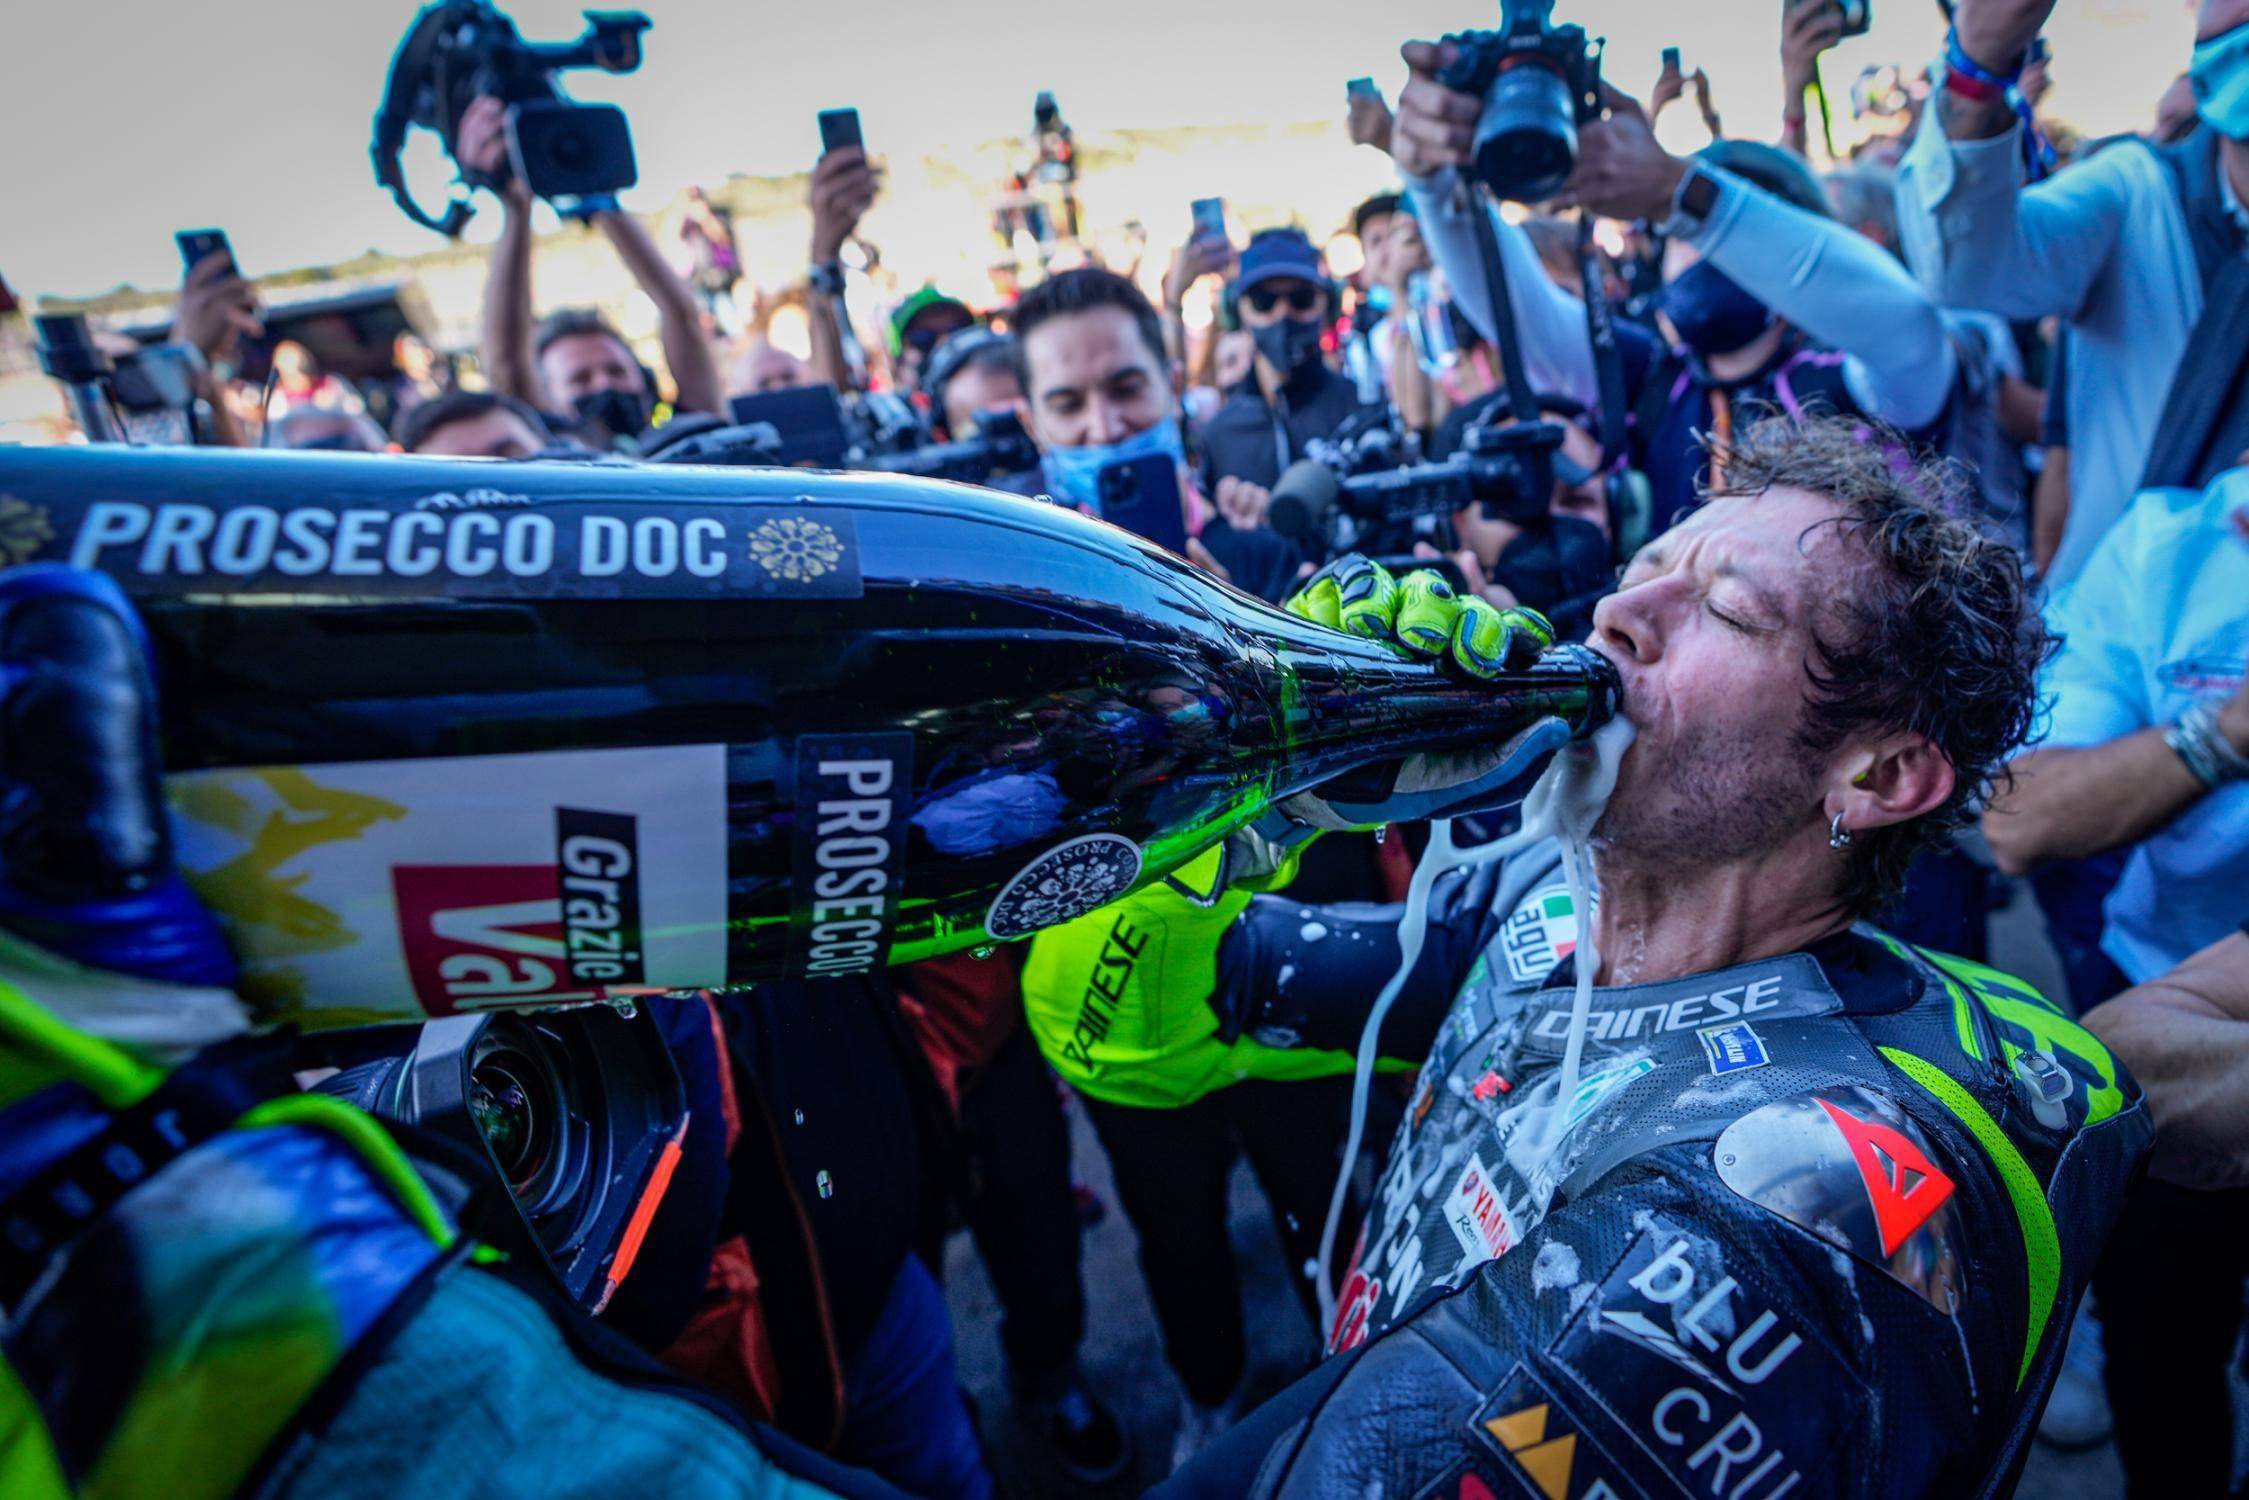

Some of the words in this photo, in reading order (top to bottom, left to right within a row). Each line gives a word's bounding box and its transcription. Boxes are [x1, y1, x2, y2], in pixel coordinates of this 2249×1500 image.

[69, 502, 555, 577] PROSECCO
[580, 514, 728, 577] DOC
[806, 759, 893, 972] PROSECCO
[430, 898, 597, 1010] Val
[1063, 912, 1150, 1073] DAINESE
[1533, 976, 1782, 1040] DAINESE
